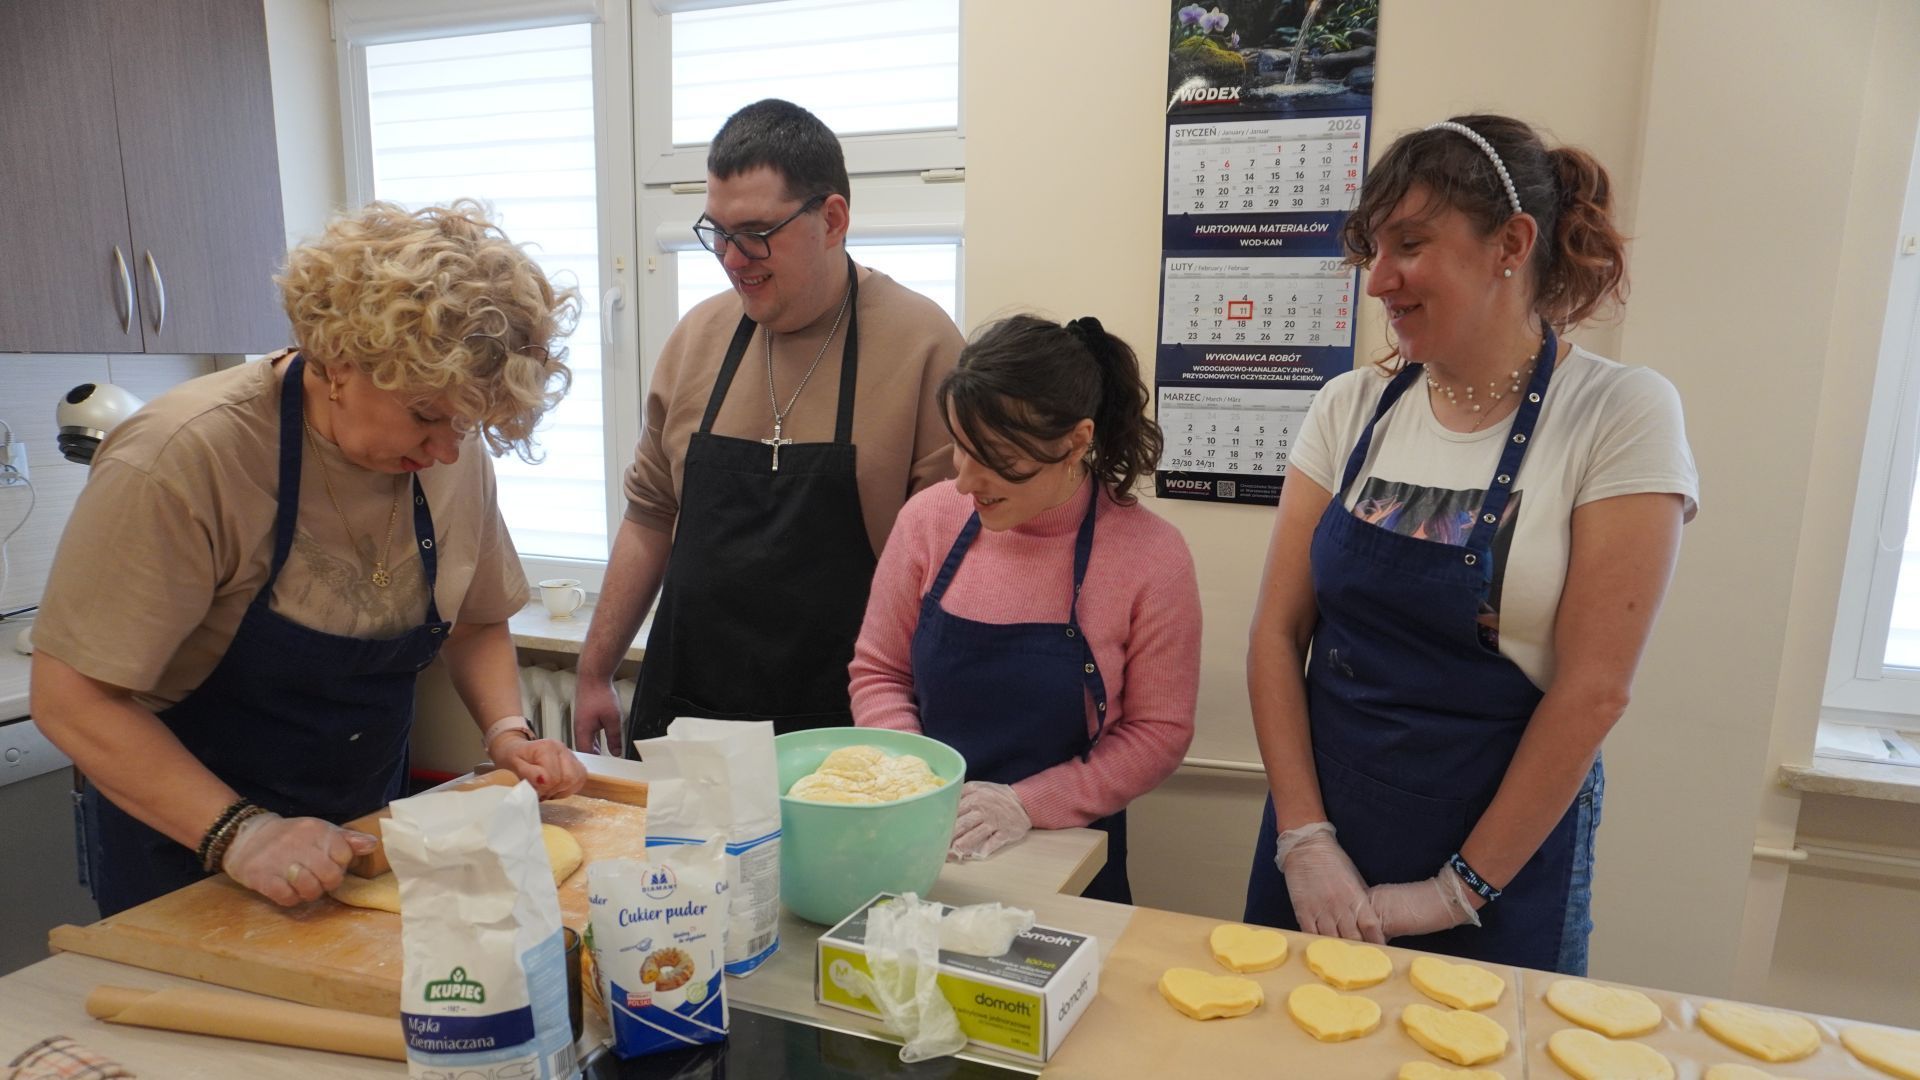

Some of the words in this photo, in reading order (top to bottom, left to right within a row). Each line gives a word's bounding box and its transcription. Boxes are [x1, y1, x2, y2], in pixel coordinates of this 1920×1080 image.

[1180, 86, 1241, 102] WODEX
[1175, 126, 1217, 138] STYCZEŃ
[1328, 119, 1361, 132] 2026
[1301, 144, 1306, 152] 2
[1327, 142, 1332, 151] 3
[1224, 160, 1230, 168] 6
[1300, 157, 1306, 165] 9
[1322, 156, 1332, 164] 10
[1350, 155, 1358, 163] 11
[1196, 174, 1205, 182] 12
[1221, 174, 1230, 182] 13
[1271, 172, 1280, 180] 15
[1296, 171, 1304, 179] 16
[1322, 170, 1331, 178] 17
[1348, 169, 1357, 178] 18
[1218, 187, 1229, 195] 20
[1245, 186, 1254, 195] 21
[1269, 186, 1280, 194] 22
[1294, 185, 1304, 193] 23
[1320, 184, 1330, 192] 24
[1219, 200, 1229, 208] 27
[1243, 200, 1253, 208] 28
[1292, 198, 1303, 206] 30
[1320, 198, 1329, 206] 31
[1195, 224, 1257, 234] HURTOWNIA
[1259, 222, 1329, 233] MATERIAŁÓW
[1171, 263, 1193, 271] LUTY
[1342, 294, 1348, 303] 8
[1338, 308, 1347, 316] 15
[1205, 353, 1267, 362] WYKONAWCA
[1269, 353, 1301, 362] ROBÓT
[1193, 366, 1313, 374] WODOCIĄGOWO-KANALIZACYJNYCH
[1291, 373, 1323, 382] ŚCIEKÓW
[1164, 393, 1201, 401] MARZEC
[1172, 458, 1192, 467] 23/30
[1196, 459, 1215, 468] 24/31
[1165, 479, 1212, 490] WODEX
[642, 884, 677, 892] DIAMANT
[619, 907, 662, 927] Cukier
[666, 900, 707, 924] puder
[835, 964, 848, 976] M
[430, 984, 482, 1000] KUPIEC
[408, 1017, 440, 1034] Mąka
[410, 1034, 495, 1050] Ziemniaczana
